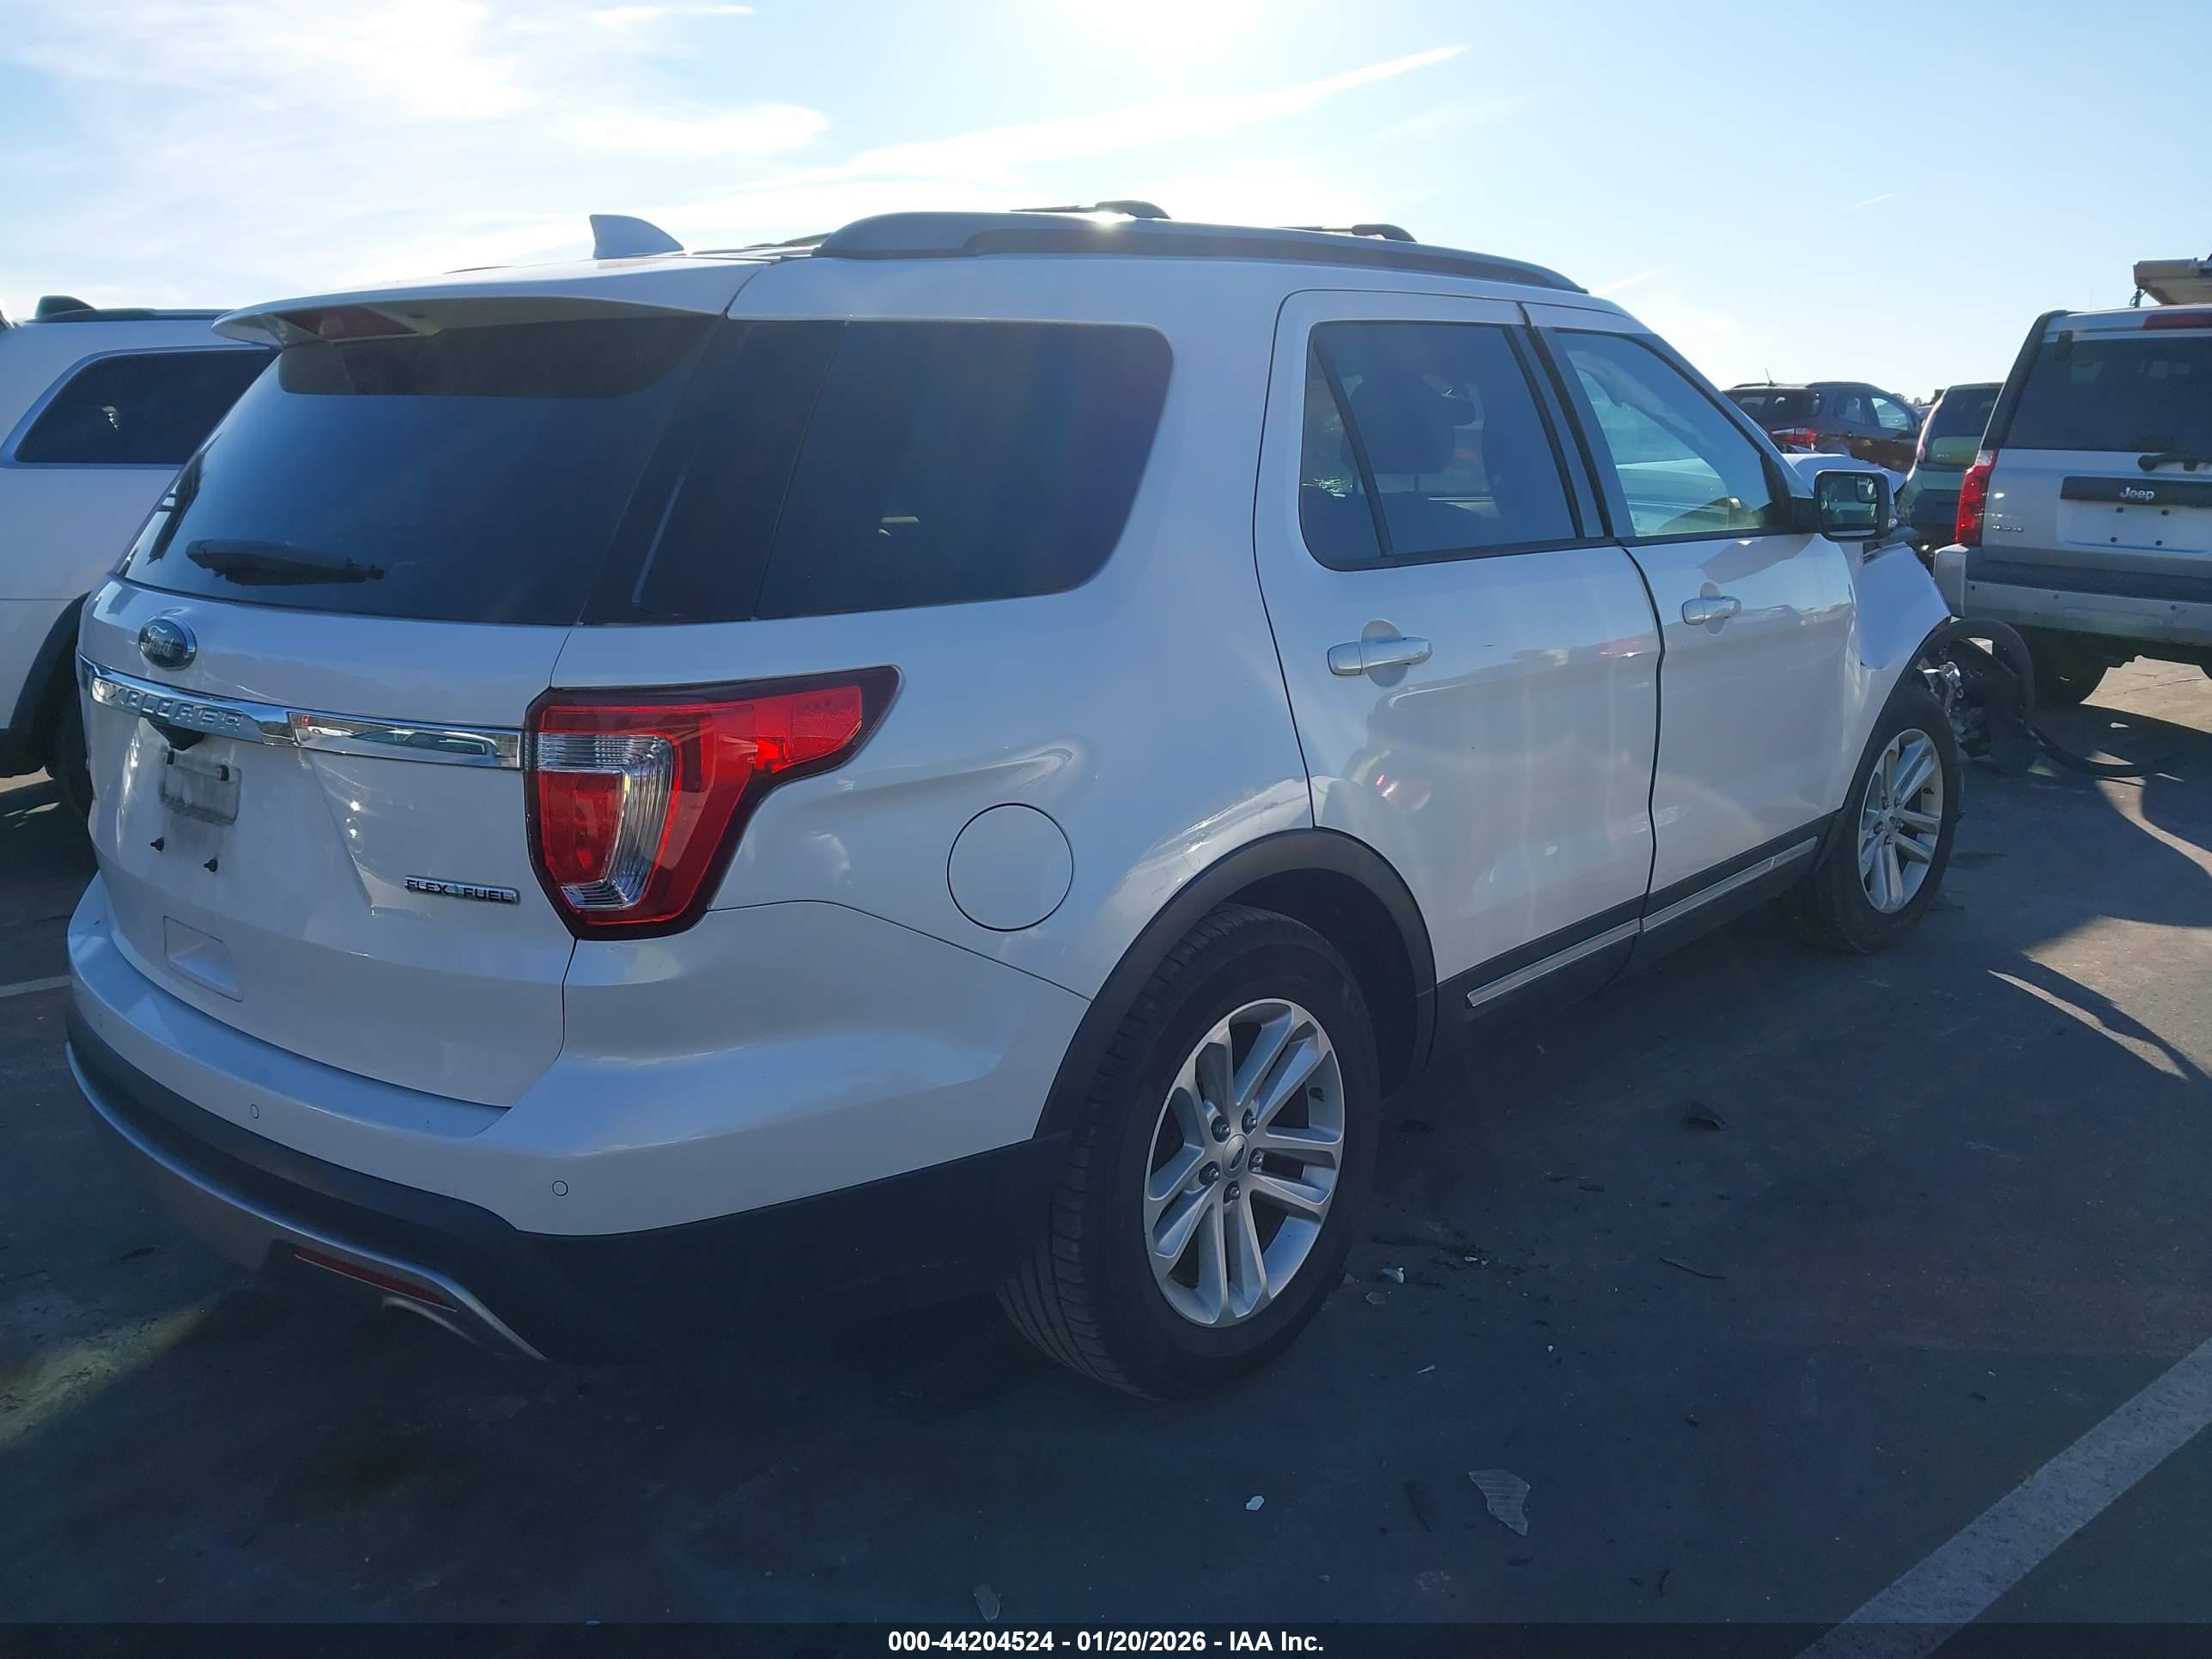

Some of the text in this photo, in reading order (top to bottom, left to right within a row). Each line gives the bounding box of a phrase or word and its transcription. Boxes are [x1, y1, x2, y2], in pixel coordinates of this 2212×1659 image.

[2120, 486, 2156, 501] Jeep
[405, 878, 516, 902] FLEX FUEL
